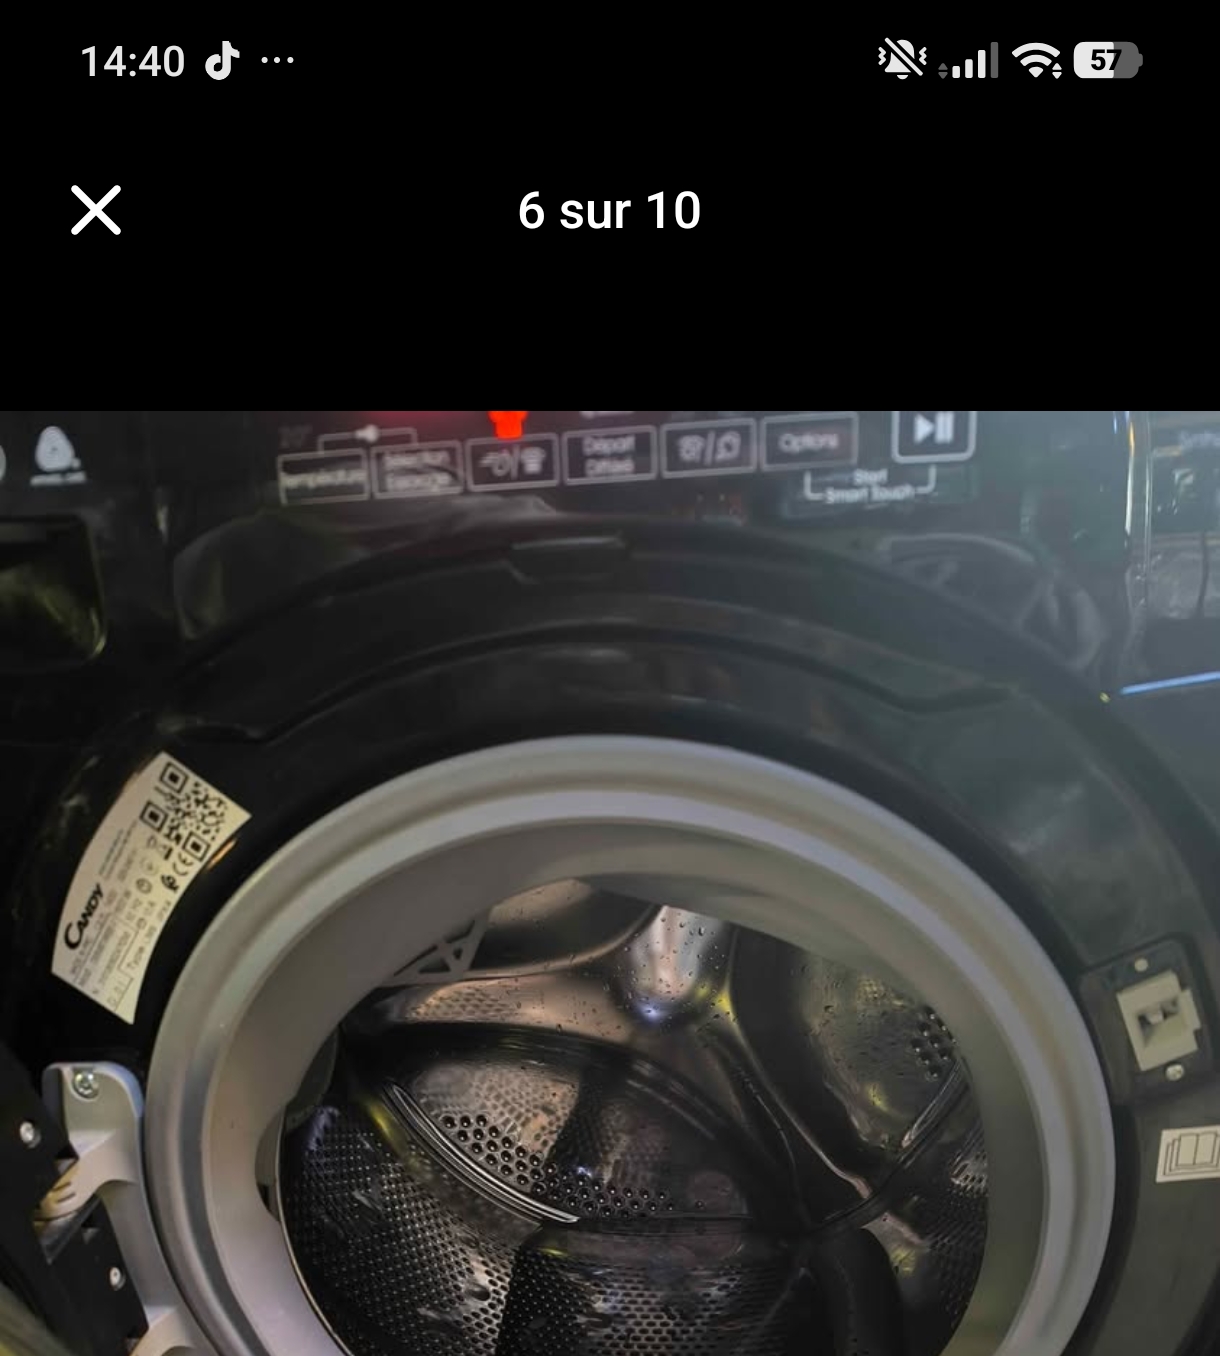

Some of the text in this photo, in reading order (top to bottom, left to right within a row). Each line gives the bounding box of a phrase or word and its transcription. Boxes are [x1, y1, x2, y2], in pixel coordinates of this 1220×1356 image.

[779, 431, 840, 453] Options
[853, 468, 888, 486] Start
[825, 484, 915, 504] Smart Touch
